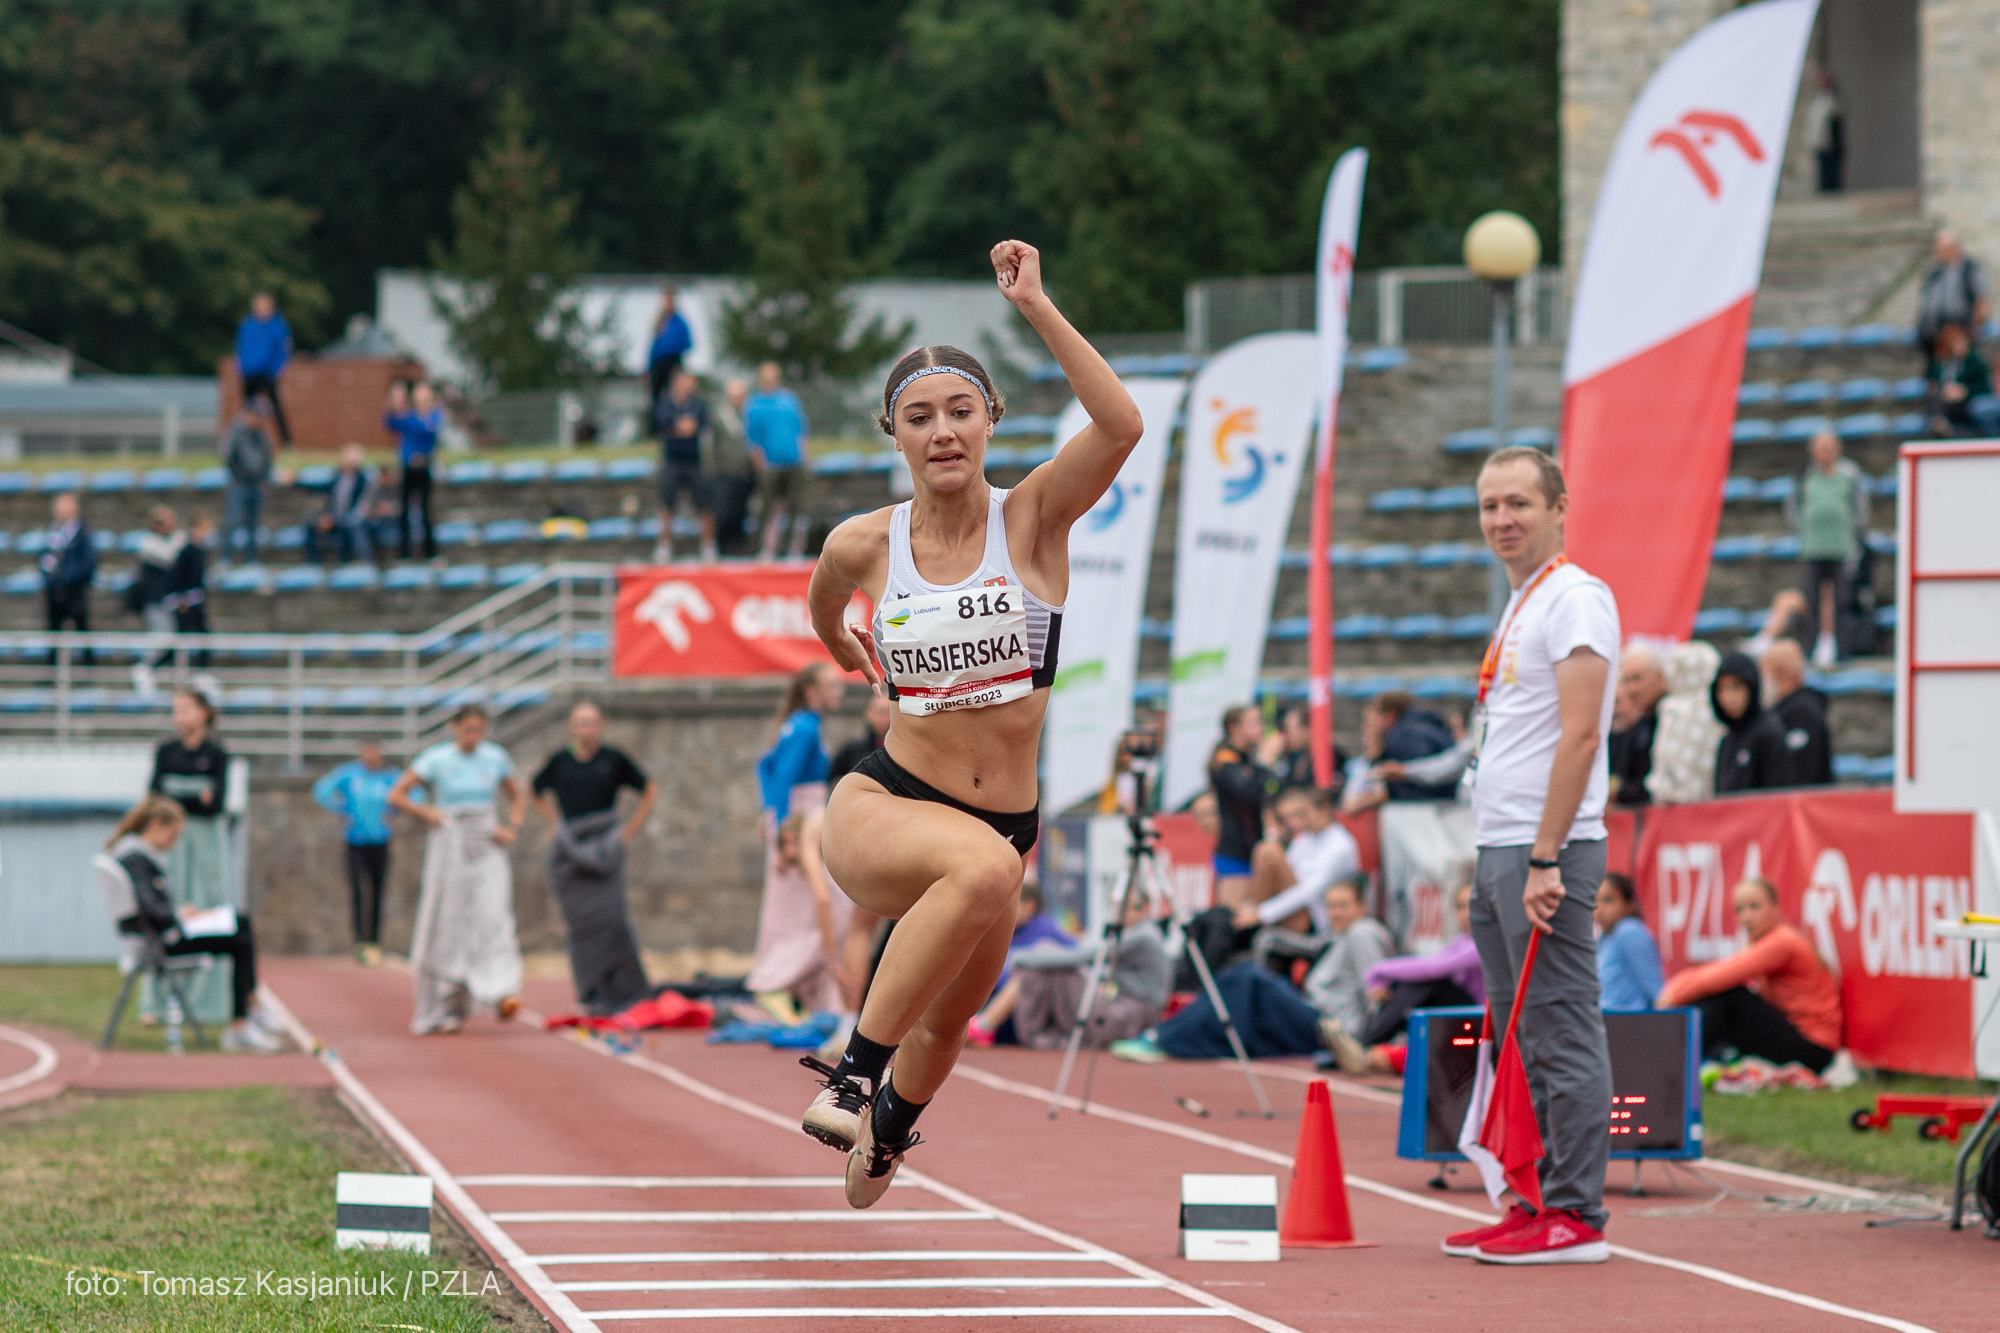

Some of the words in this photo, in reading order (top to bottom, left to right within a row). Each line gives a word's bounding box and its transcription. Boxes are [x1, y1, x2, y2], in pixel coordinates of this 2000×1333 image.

[958, 592, 1010, 619] 816
[891, 633, 1024, 674] STASIERSKA
[924, 698, 972, 711] SŁUBICE
[974, 689, 1002, 704] 2023
[1860, 872, 1970, 979] ORLEN
